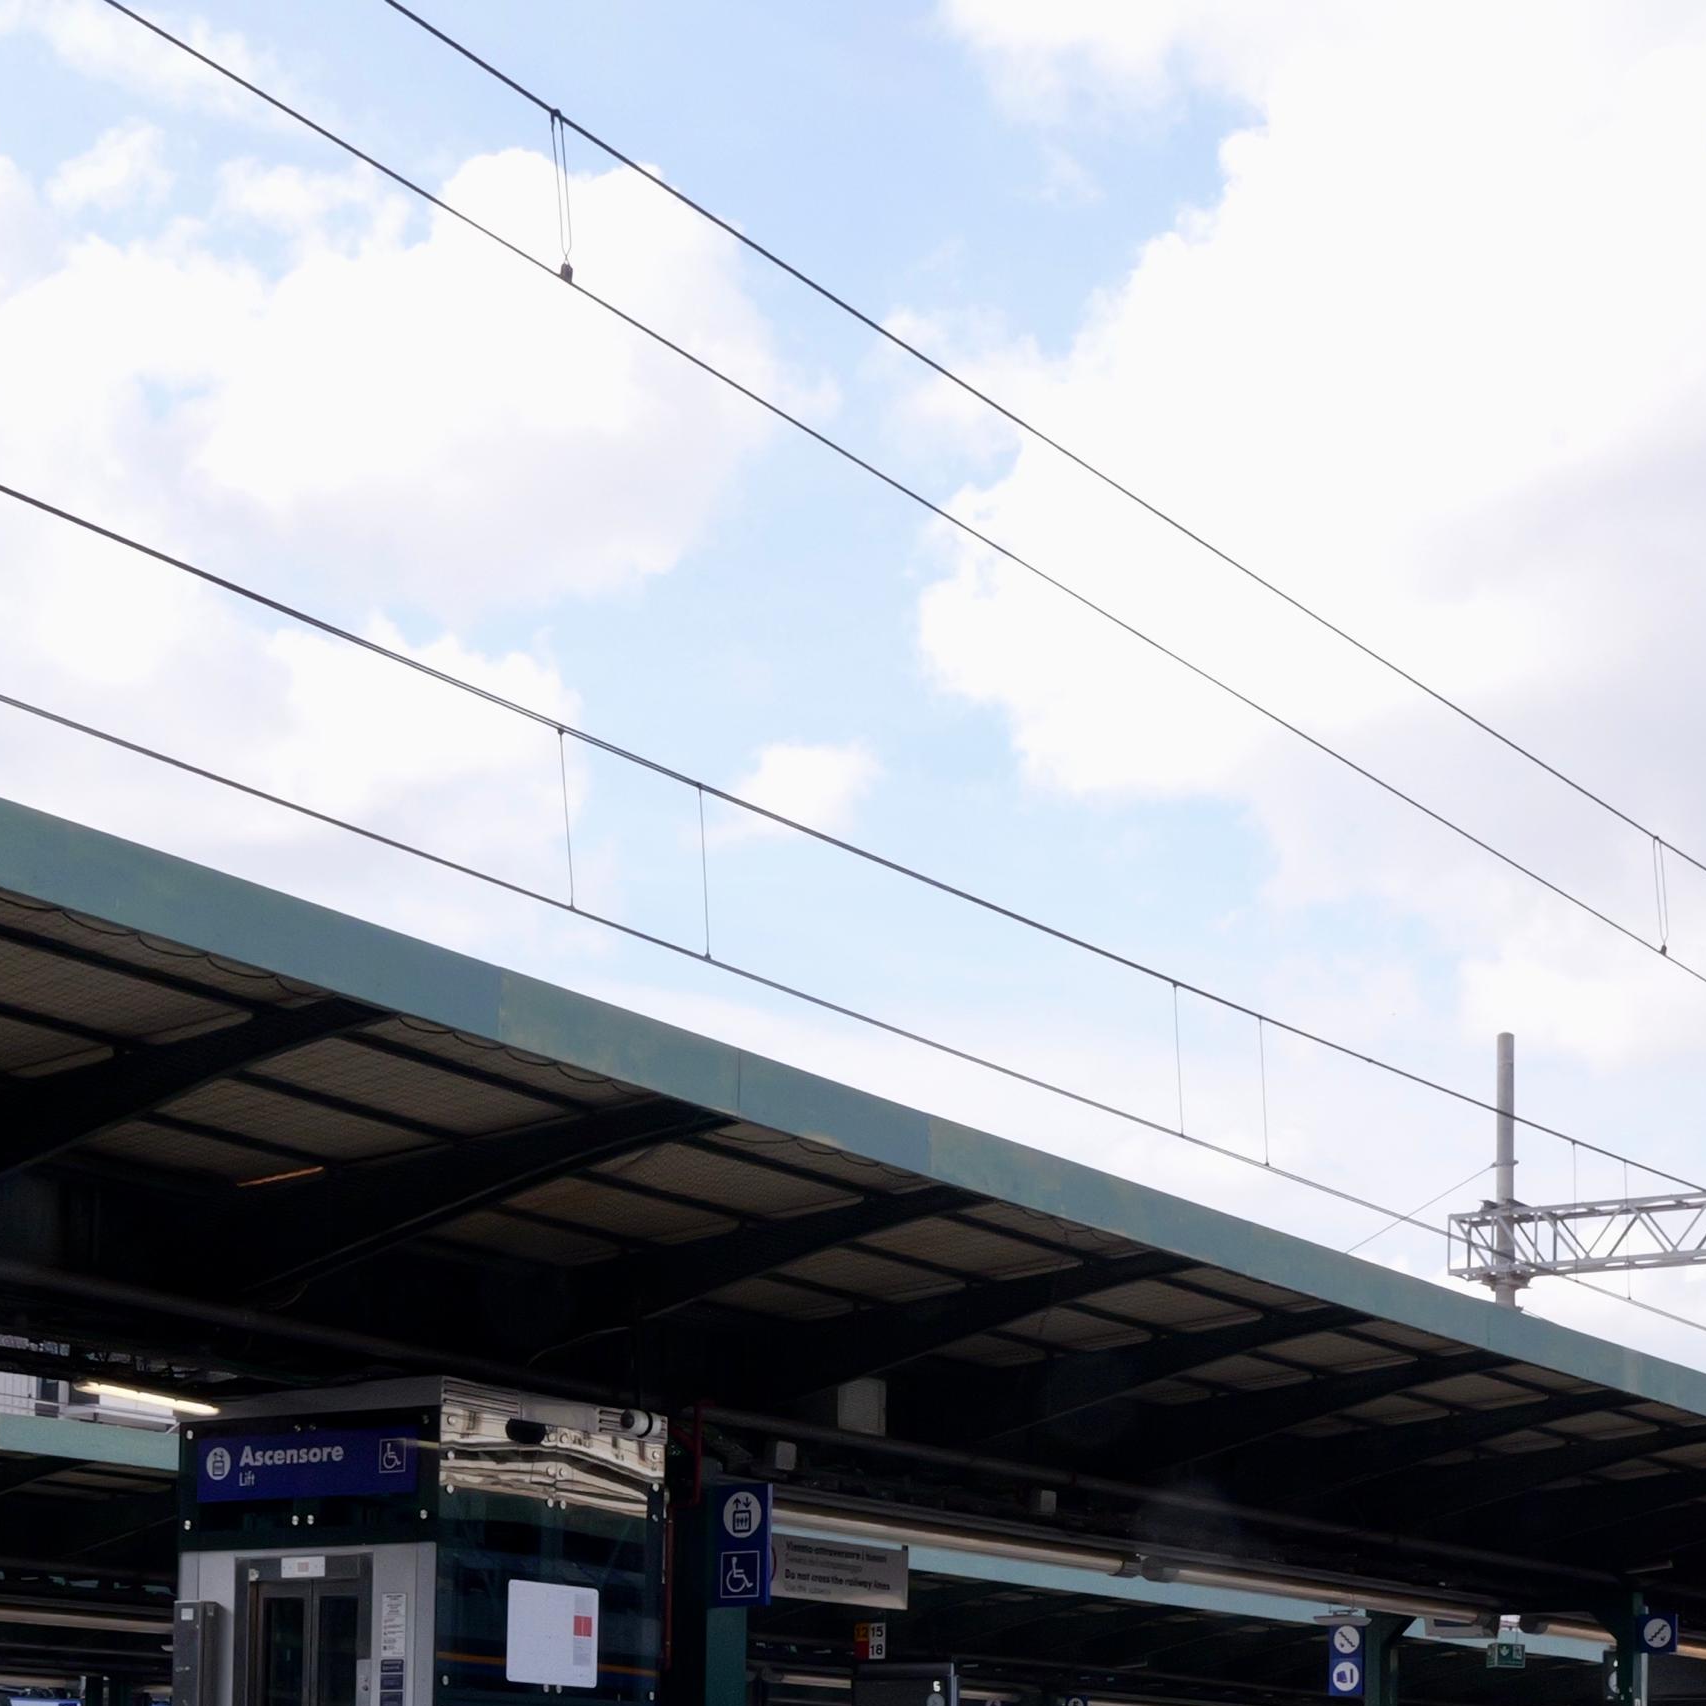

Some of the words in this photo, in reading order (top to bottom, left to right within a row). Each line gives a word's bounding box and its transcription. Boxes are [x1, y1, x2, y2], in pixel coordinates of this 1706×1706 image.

[239, 1443, 344, 1468] Ascensore
[239, 1471, 255, 1487] Lift
[785, 1568, 795, 1579] Do
[797, 1571, 810, 1581] not
[812, 1573, 831, 1584] cross
[832, 1573, 843, 1585] the
[871, 1626, 883, 1638] 15
[870, 1644, 883, 1656] 18
